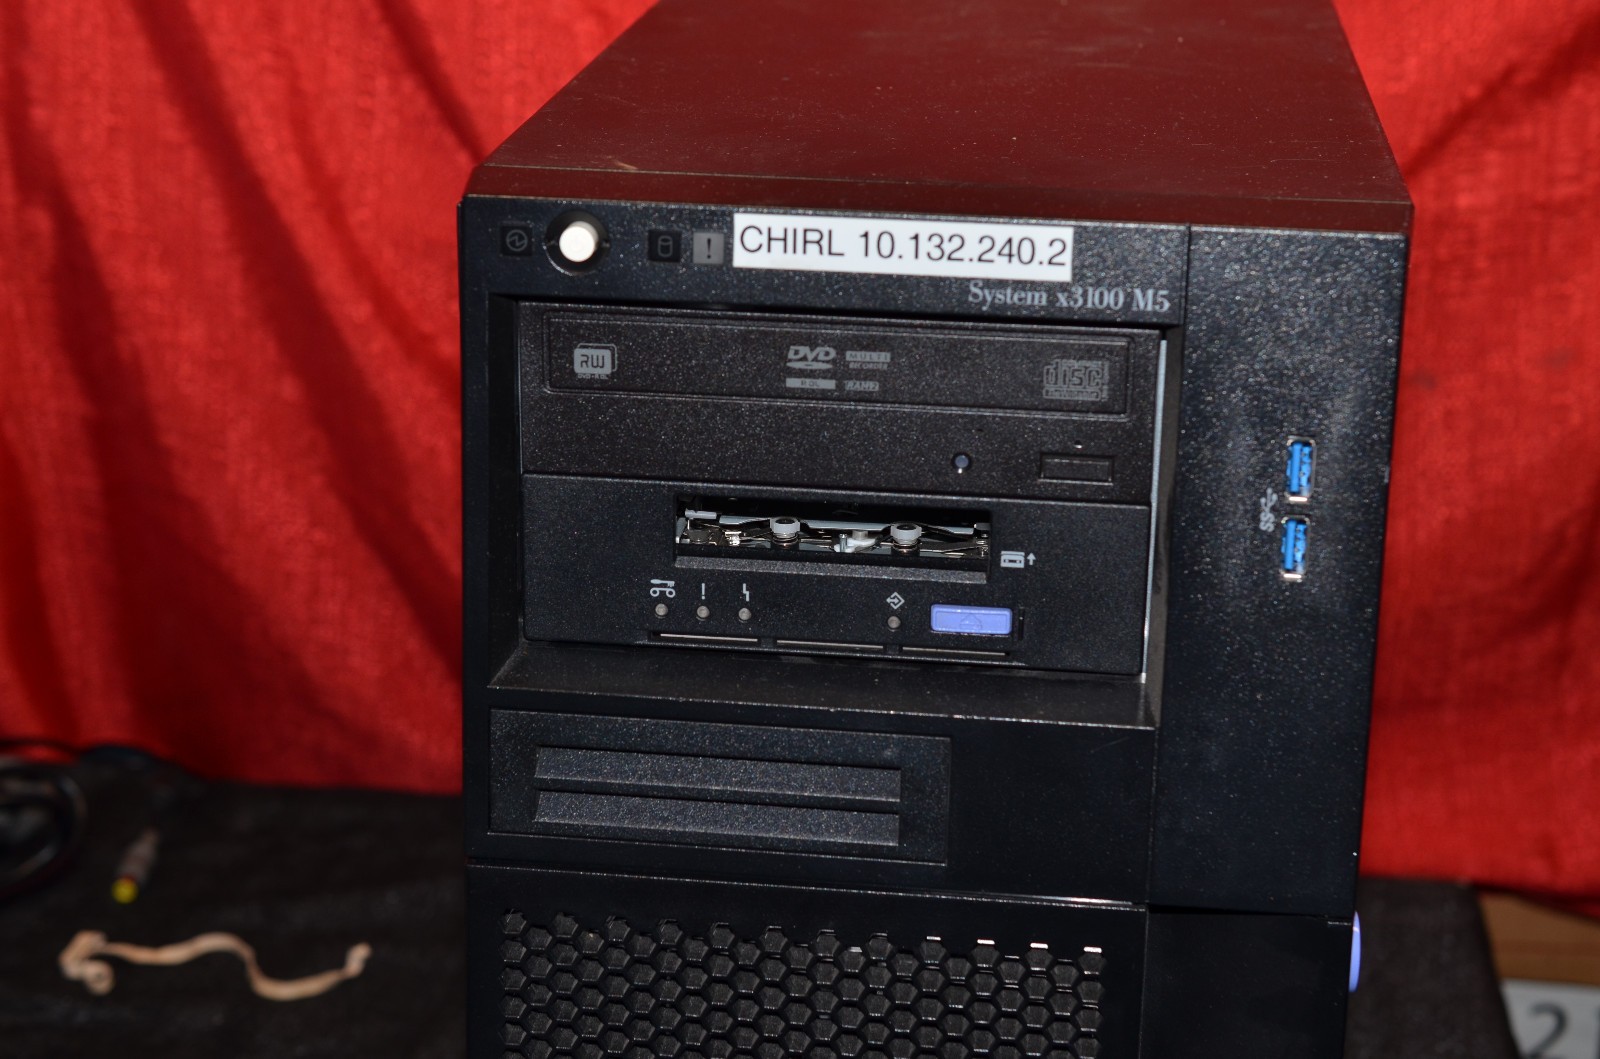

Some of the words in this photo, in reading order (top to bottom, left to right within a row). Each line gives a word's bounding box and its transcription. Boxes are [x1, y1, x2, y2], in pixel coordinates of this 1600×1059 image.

[740, 225, 845, 256] CHIRL
[859, 230, 1067, 267] 10.132.240.2
[968, 279, 1048, 311] System
[1055, 285, 1125, 311] x3100
[1132, 287, 1171, 312] M5
[580, 354, 605, 369] RW
[787, 345, 837, 361] DVD
